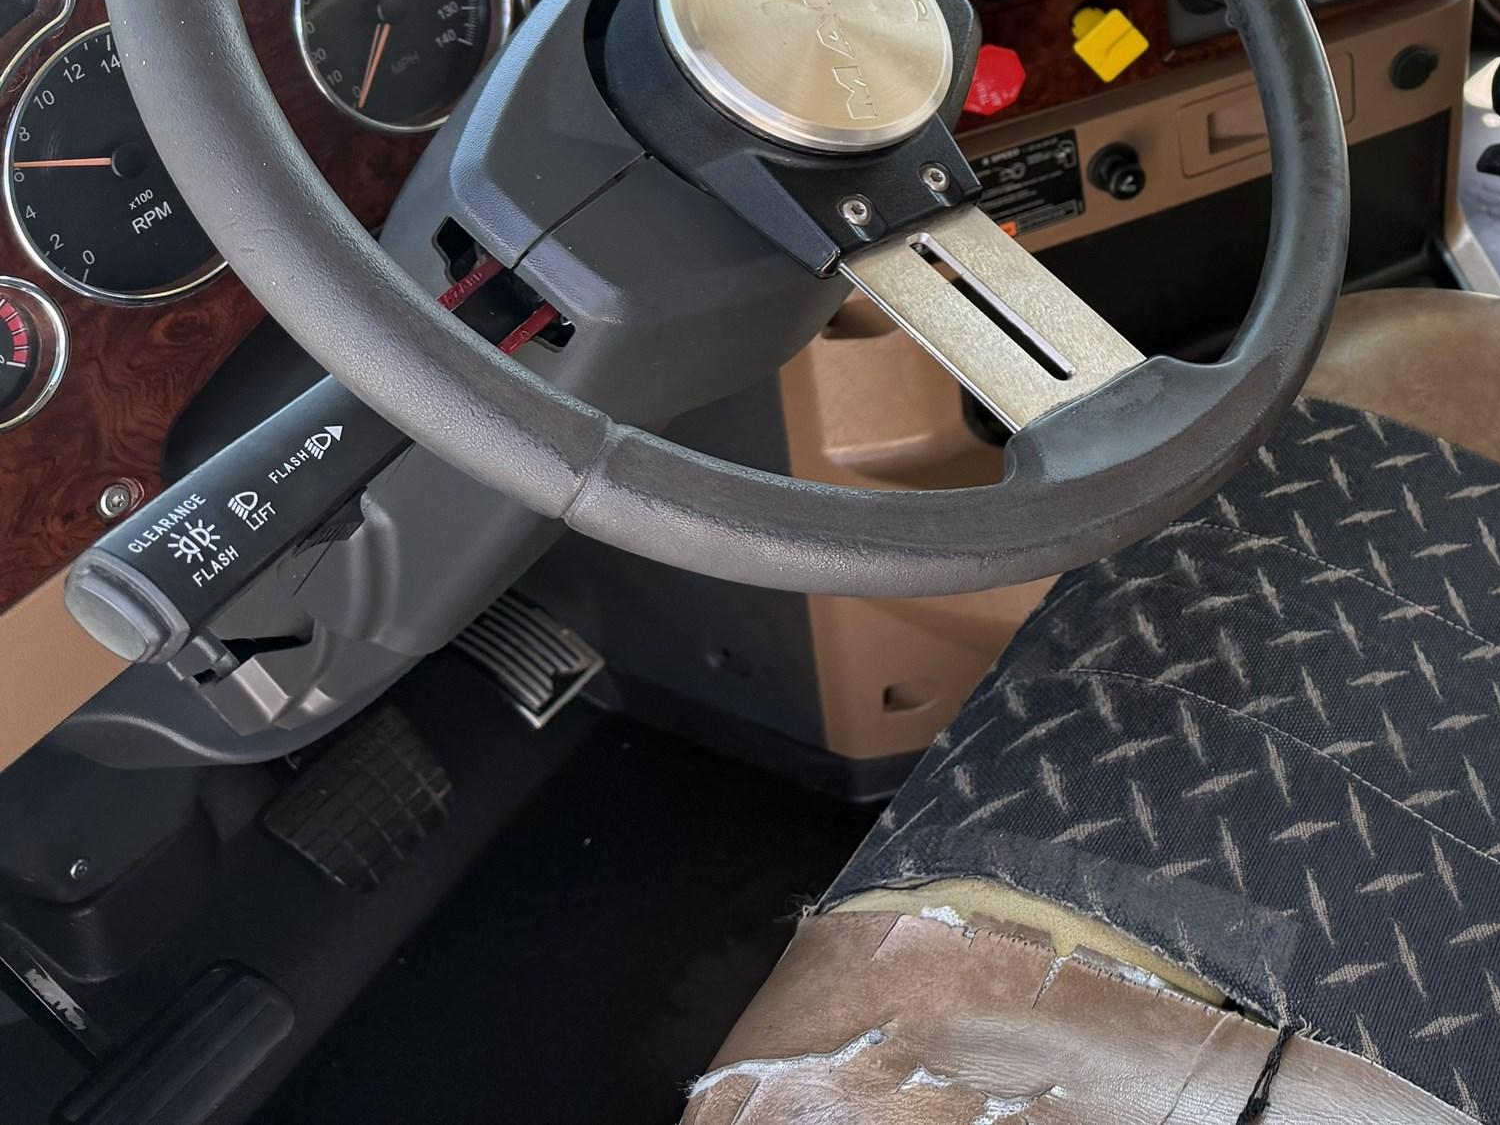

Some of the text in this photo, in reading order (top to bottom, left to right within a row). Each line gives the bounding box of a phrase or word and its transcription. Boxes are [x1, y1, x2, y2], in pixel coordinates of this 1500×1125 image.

[437, 1, 459, 20] 130
[436, 29, 457, 48] 140
[63, 63, 85, 83] 12
[100, 54, 121, 73] 14
[327, 70, 343, 87] 10
[34, 90, 55, 110] 10
[18, 126, 30, 142] 8
[128, 189, 153, 210] x100
[25, 205, 36, 220] 4
[132, 201, 173, 234] RPM
[50, 234, 64, 250] 2
[83, 250, 95, 265] 0
[268, 449, 310, 484] FLASH
[127, 493, 206, 554] CLEARANCE
[246, 501, 276, 531] LIFT
[192, 545, 240, 587] FLASH
